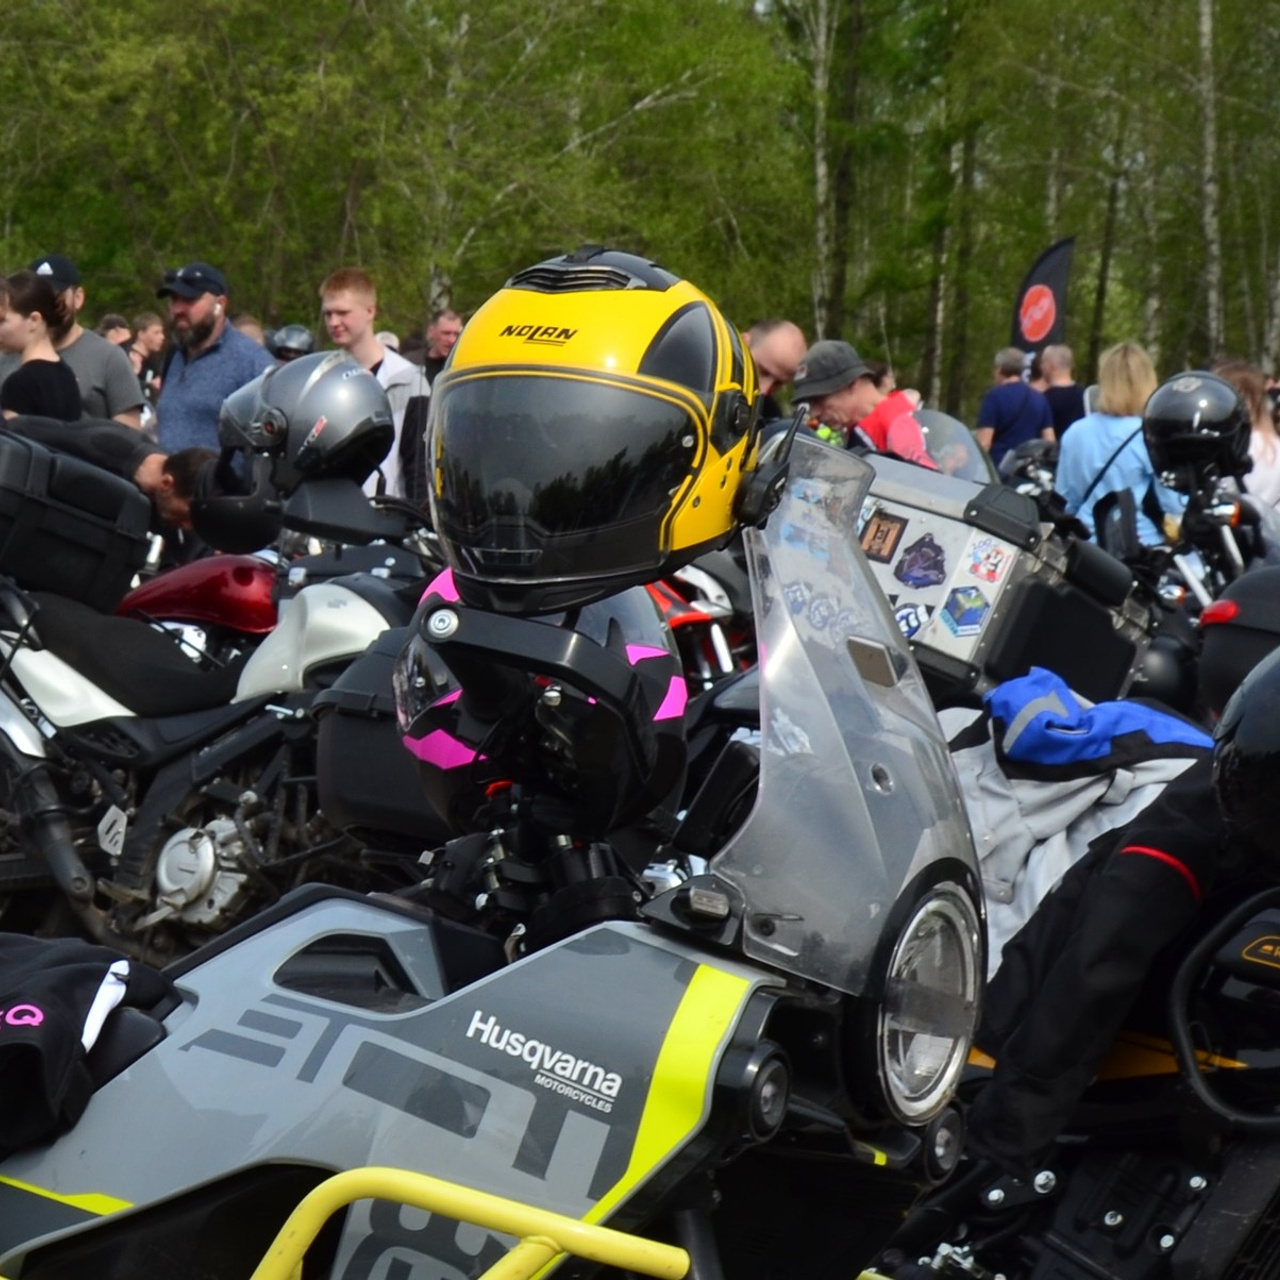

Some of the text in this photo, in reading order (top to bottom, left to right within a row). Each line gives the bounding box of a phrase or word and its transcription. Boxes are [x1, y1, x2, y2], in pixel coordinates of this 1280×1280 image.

[499, 325, 578, 342] NOLAN
[466, 1010, 623, 1098] Husqvarna
[534, 1074, 613, 1113] MOTORCYCLES
